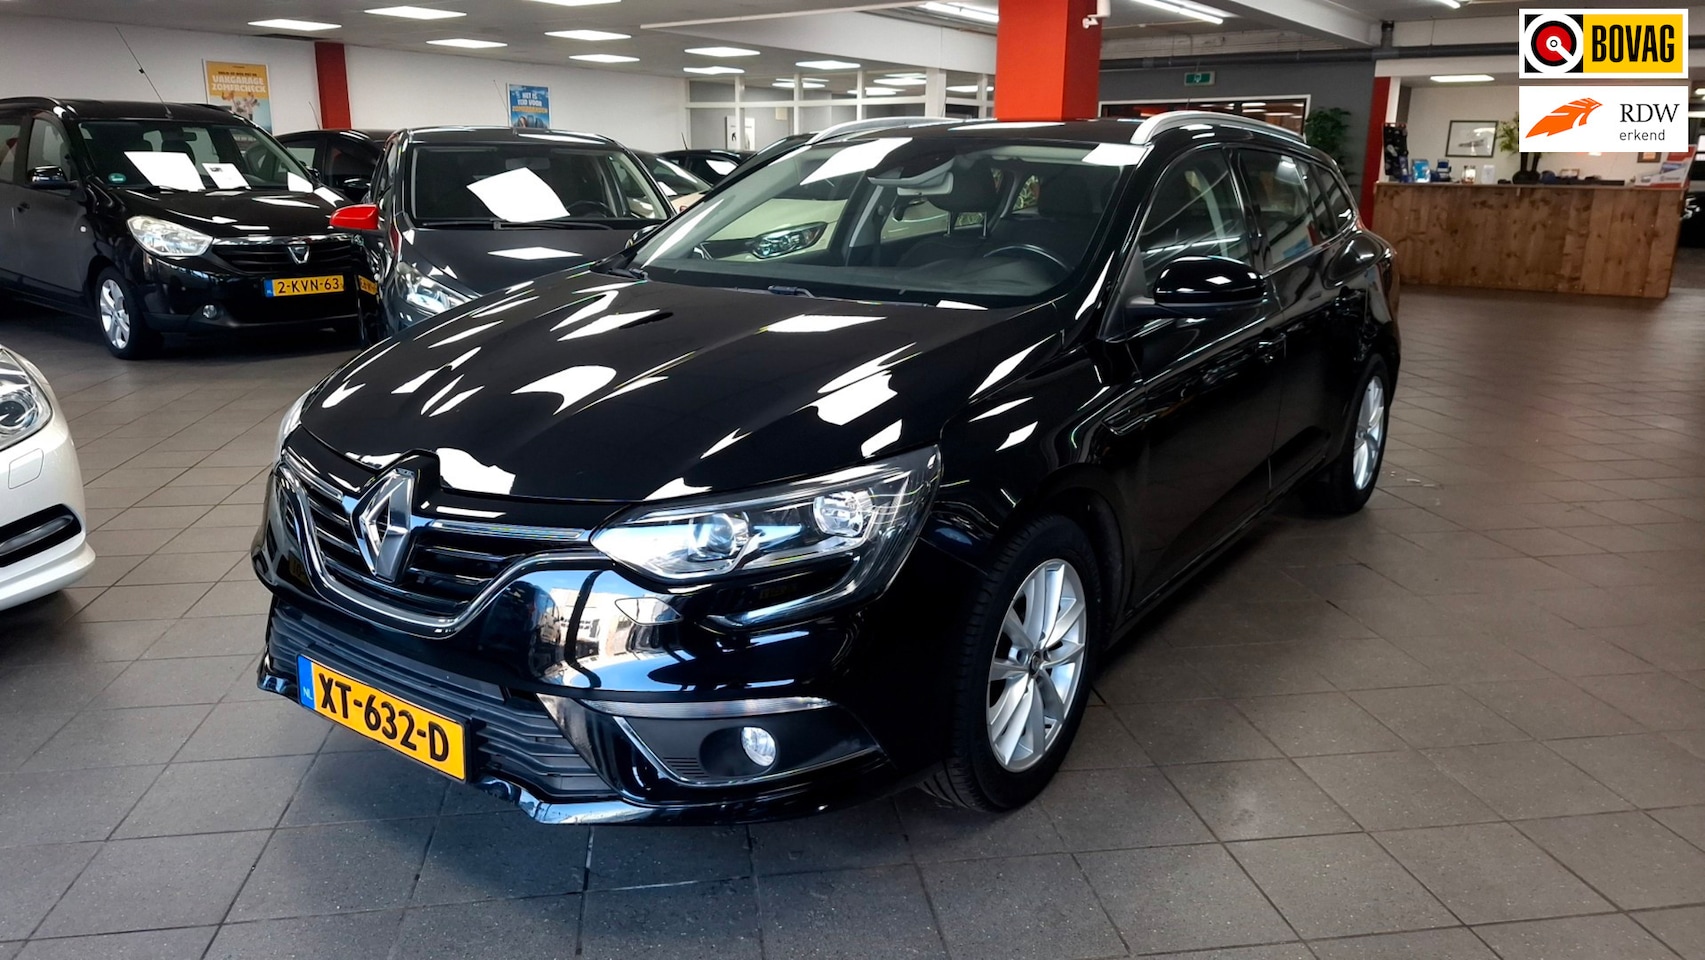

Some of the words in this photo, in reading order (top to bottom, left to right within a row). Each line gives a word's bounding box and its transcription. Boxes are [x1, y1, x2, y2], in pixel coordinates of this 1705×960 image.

[212, 75, 264, 85] VAKGARAGE
[277, 277, 340, 294] 2-KVN-63
[302, 687, 313, 700] NL
[318, 672, 450, 762] XT-632-D
